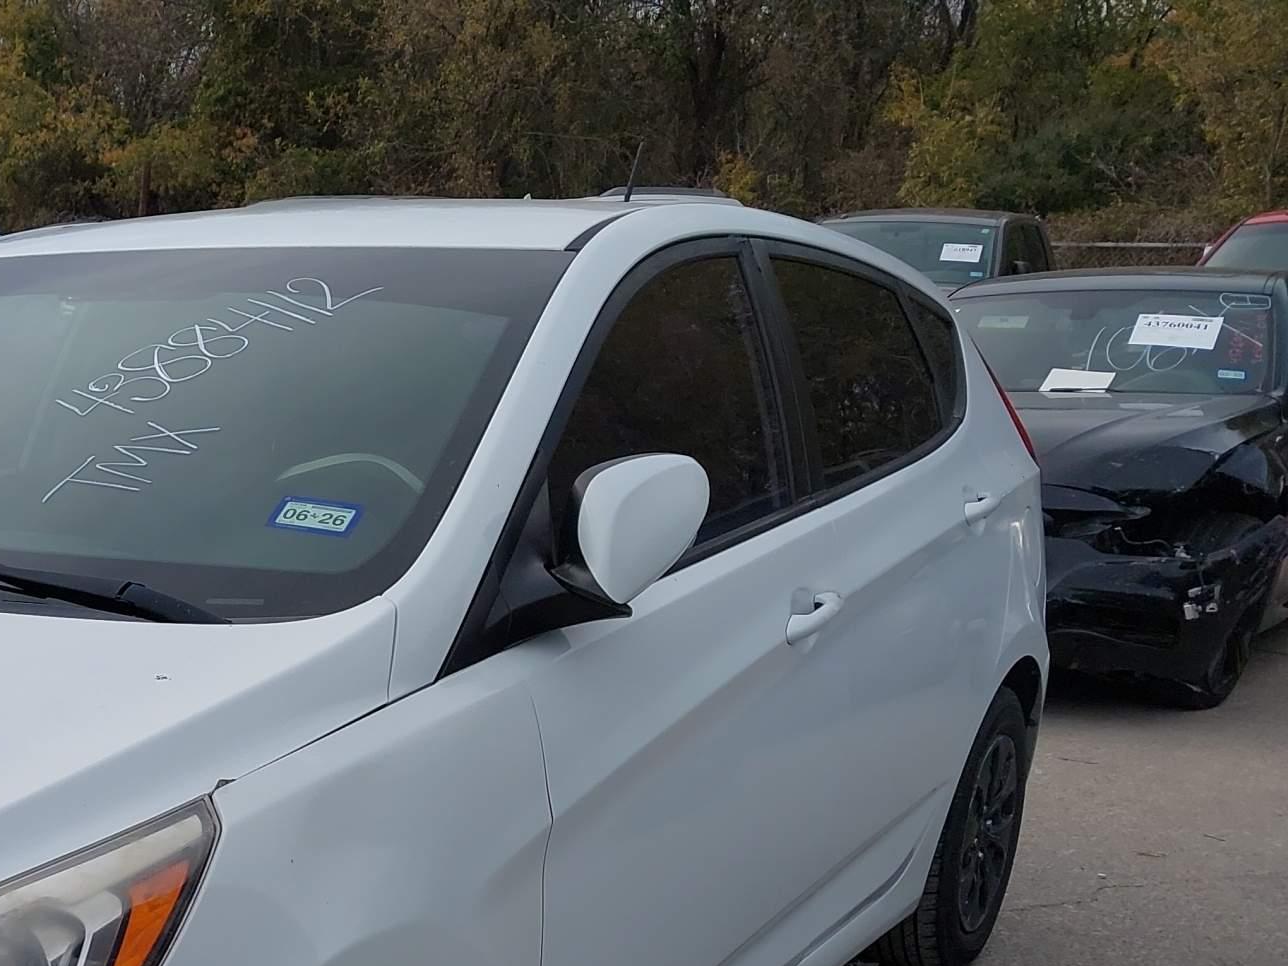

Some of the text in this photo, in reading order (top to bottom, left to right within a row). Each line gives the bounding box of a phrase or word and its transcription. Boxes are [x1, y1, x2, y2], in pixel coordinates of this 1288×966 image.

[55, 277, 385, 416] 43884112
[1143, 320, 1211, 332] 43760041
[41, 421, 221, 504] TMX
